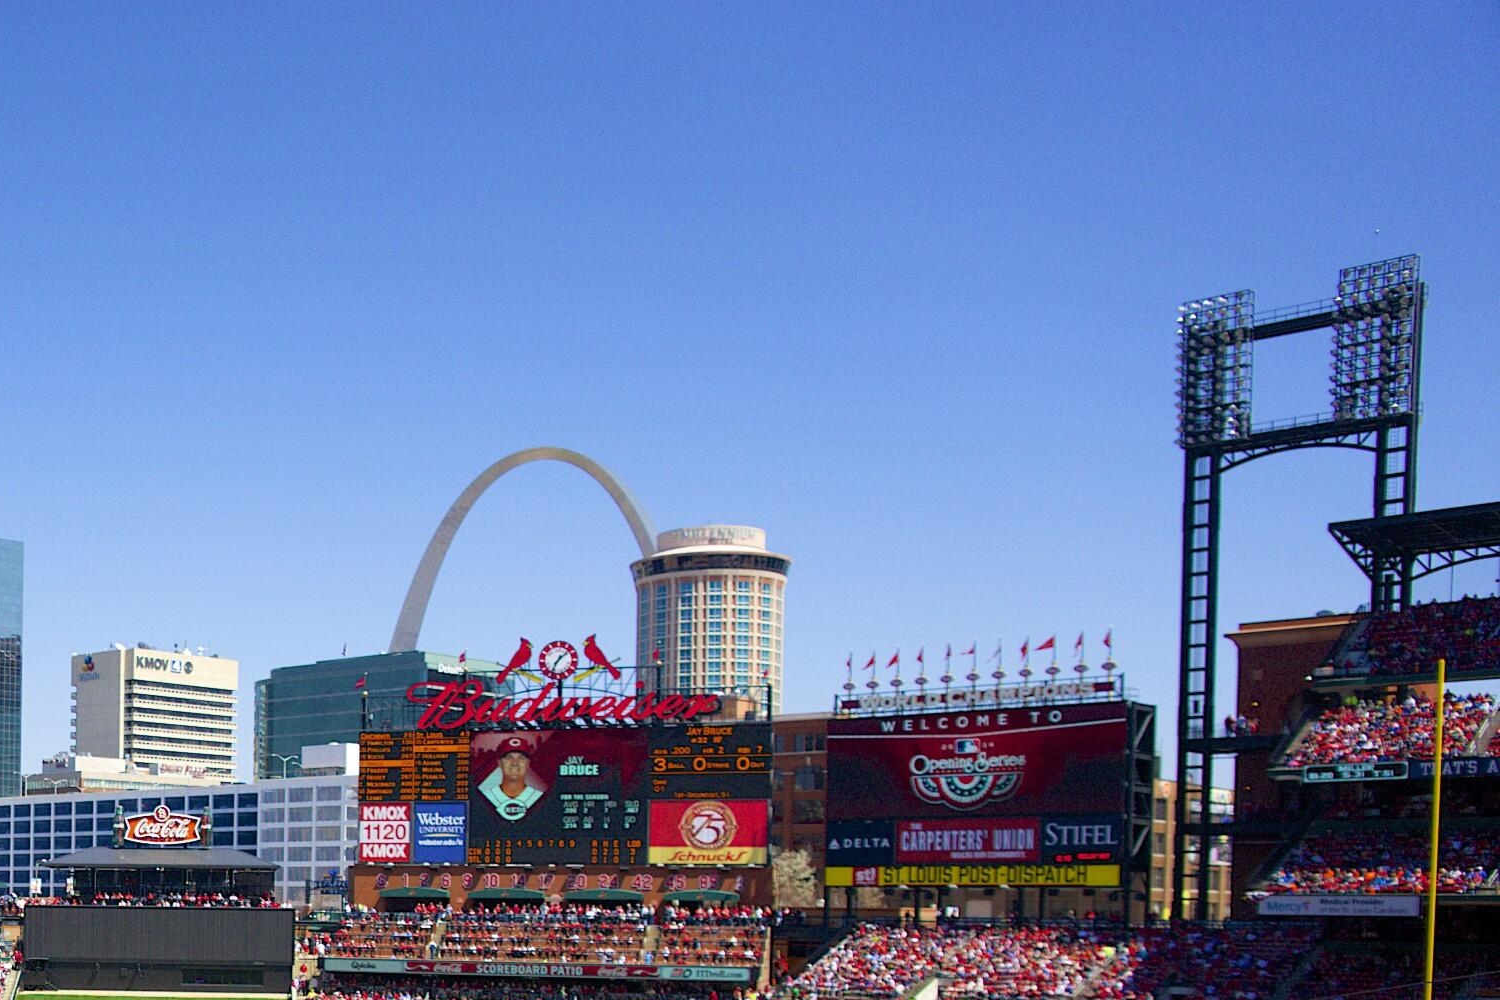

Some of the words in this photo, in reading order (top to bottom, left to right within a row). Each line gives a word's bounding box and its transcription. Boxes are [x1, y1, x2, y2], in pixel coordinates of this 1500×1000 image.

[136, 655, 169, 672] KMOV
[859, 693, 944, 711] WORLD
[947, 682, 1096, 707] CHAMPIONS
[406, 680, 719, 730] Budweiser
[881, 713, 1008, 733] WELCOME
[1030, 710, 1063, 724] TO
[686, 727, 702, 736] JAY
[703, 726, 733, 736] BRUCE
[717, 746, 724, 754] 2
[756, 744, 763, 753] 7
[565, 755, 584, 765] JAY
[653, 757, 667, 772] 3
[692, 756, 707, 772] 0
[736, 756, 751, 771] 0
[909, 753, 974, 775] Opening
[972, 751, 1027, 772] Series
[1487, 761, 1499, 773] A
[560, 764, 600, 776] BRUCE
[362, 806, 408, 821] KMOX
[416, 812, 466, 826] Webster
[134, 817, 192, 839] Coca-Cola
[364, 824, 406, 840] 1120
[418, 826, 465, 834] UNIVERSITY
[690, 813, 727, 845] 75
[1045, 822, 1119, 847] STIFEL
[843, 837, 891, 849] DELTA
[902, 829, 989, 851] CARPENTERS'
[992, 828, 1035, 850] UNION
[362, 844, 407, 858] KMOX
[668, 851, 748, 862] Schnucks
[403, 872, 409, 889] 1
[419, 872, 430, 889] 2
[440, 872, 452, 889] 6
[462, 872, 473, 889] 9
[484, 872, 500, 889] 10
[510, 872, 527, 888] 14
[538, 873, 555, 889] 17
[566, 874, 587, 889] 20
[598, 874, 619, 889] 24
[632, 874, 654, 890] 42
[664, 874, 686, 890] 45
[699, 874, 718, 890] 85
[883, 868, 903, 884] ST.
[908, 867, 952, 884] LOUIS
[959, 865, 1088, 884] POST-DISPATCH
[476, 963, 547, 976] SCOREBOARD
[550, 965, 583, 976] PATIO
